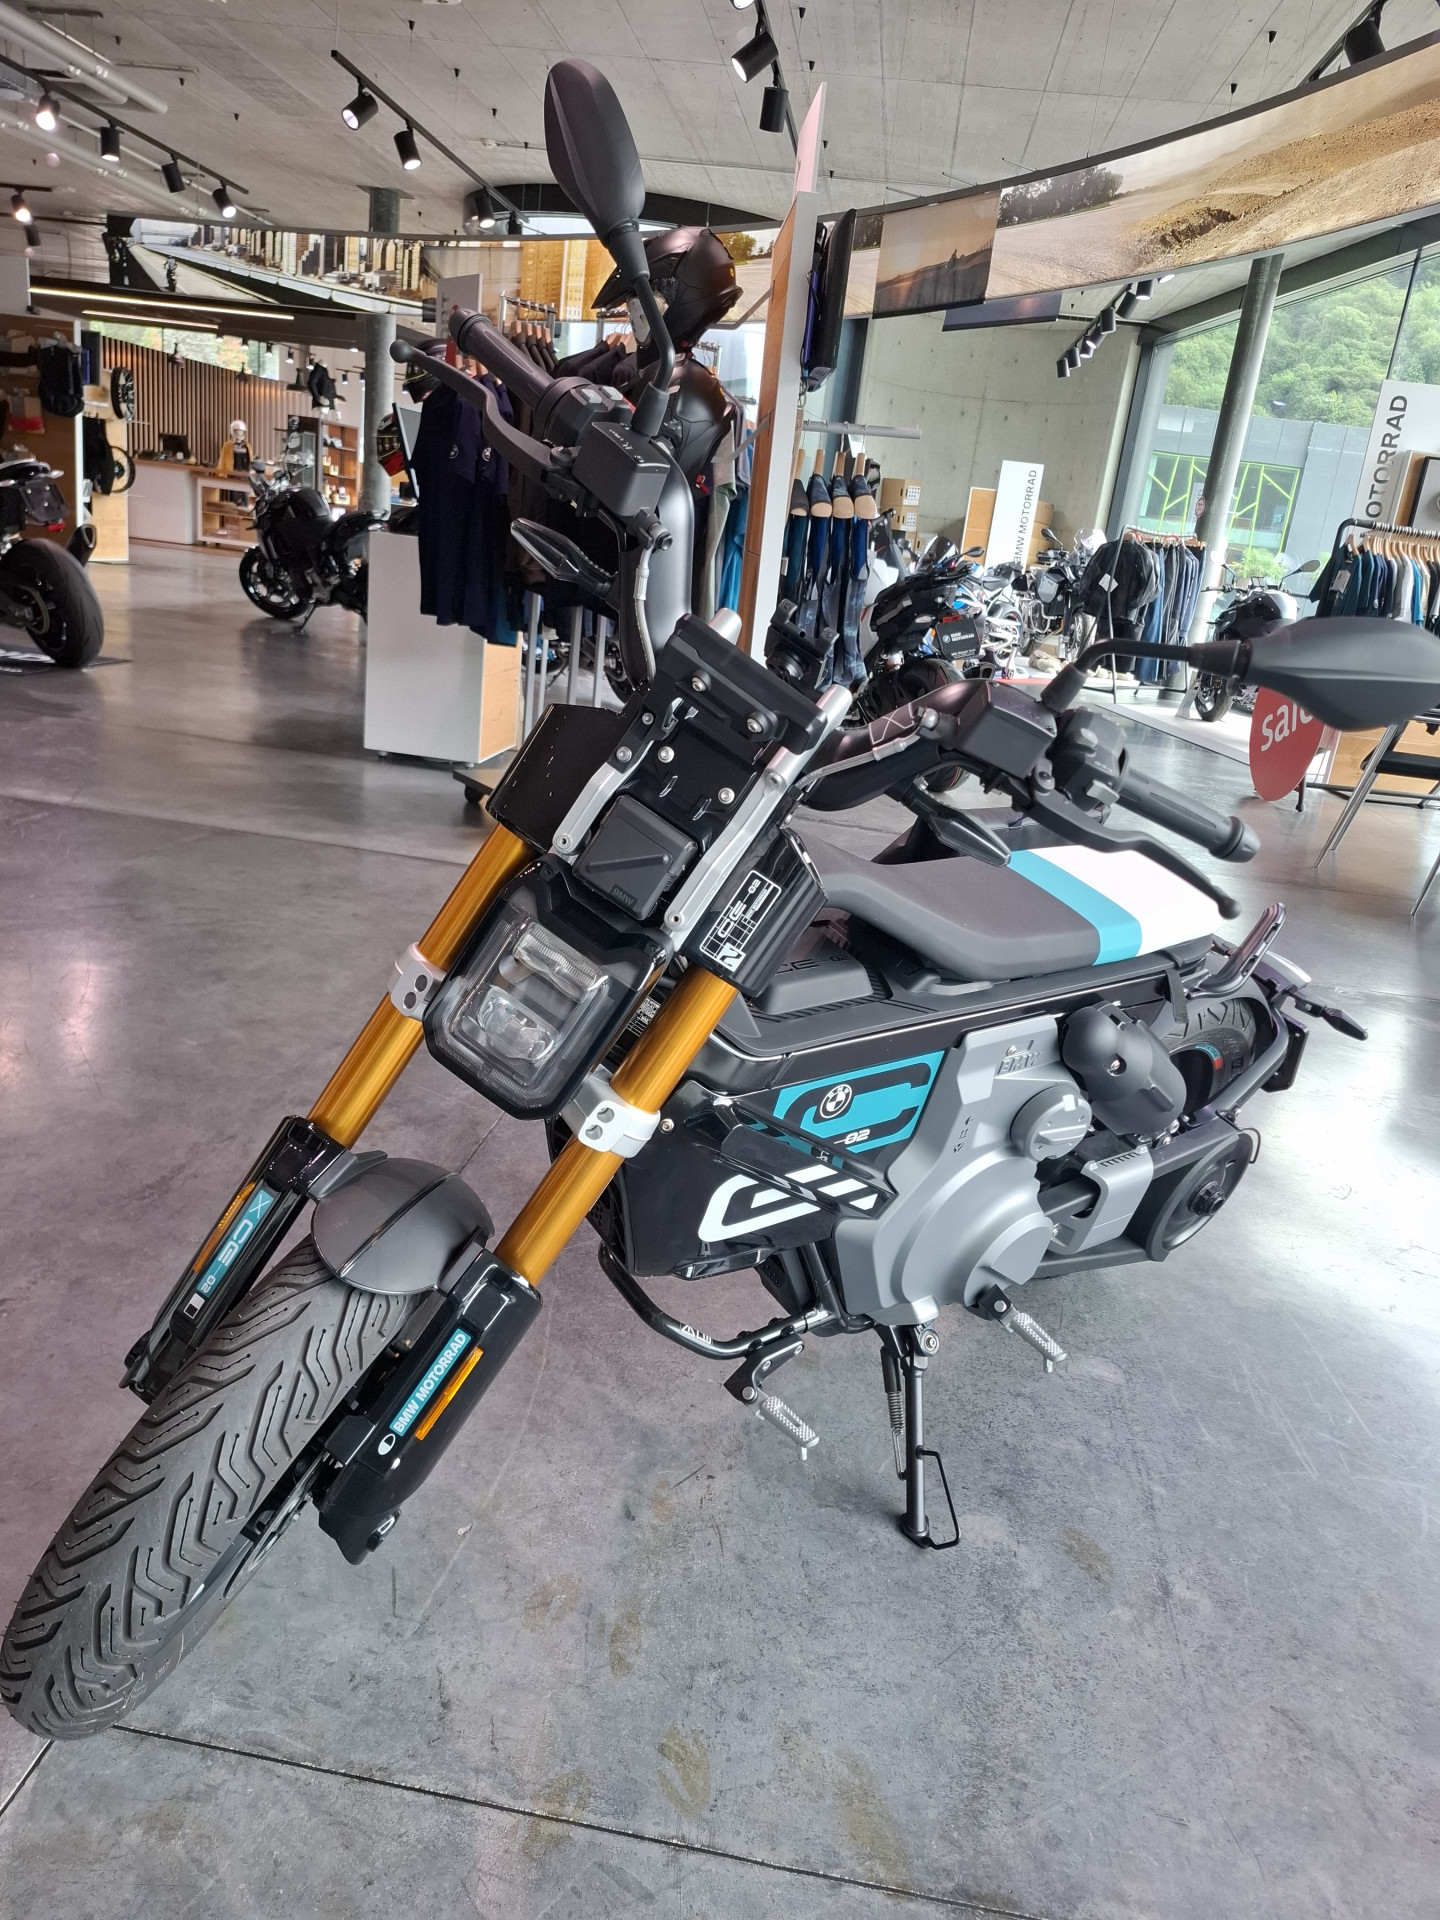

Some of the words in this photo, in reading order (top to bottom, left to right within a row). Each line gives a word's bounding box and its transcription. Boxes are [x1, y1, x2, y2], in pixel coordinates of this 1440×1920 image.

[1365, 395, 1408, 518] OTORRAD
[1019, 469, 1037, 535] MOTORRAD
[611, 887, 635, 907] BMW
[997, 1051, 1042, 1075] BMW
[393, 1399, 420, 1433] BMW
[414, 1333, 467, 1402] MOTORRAD
